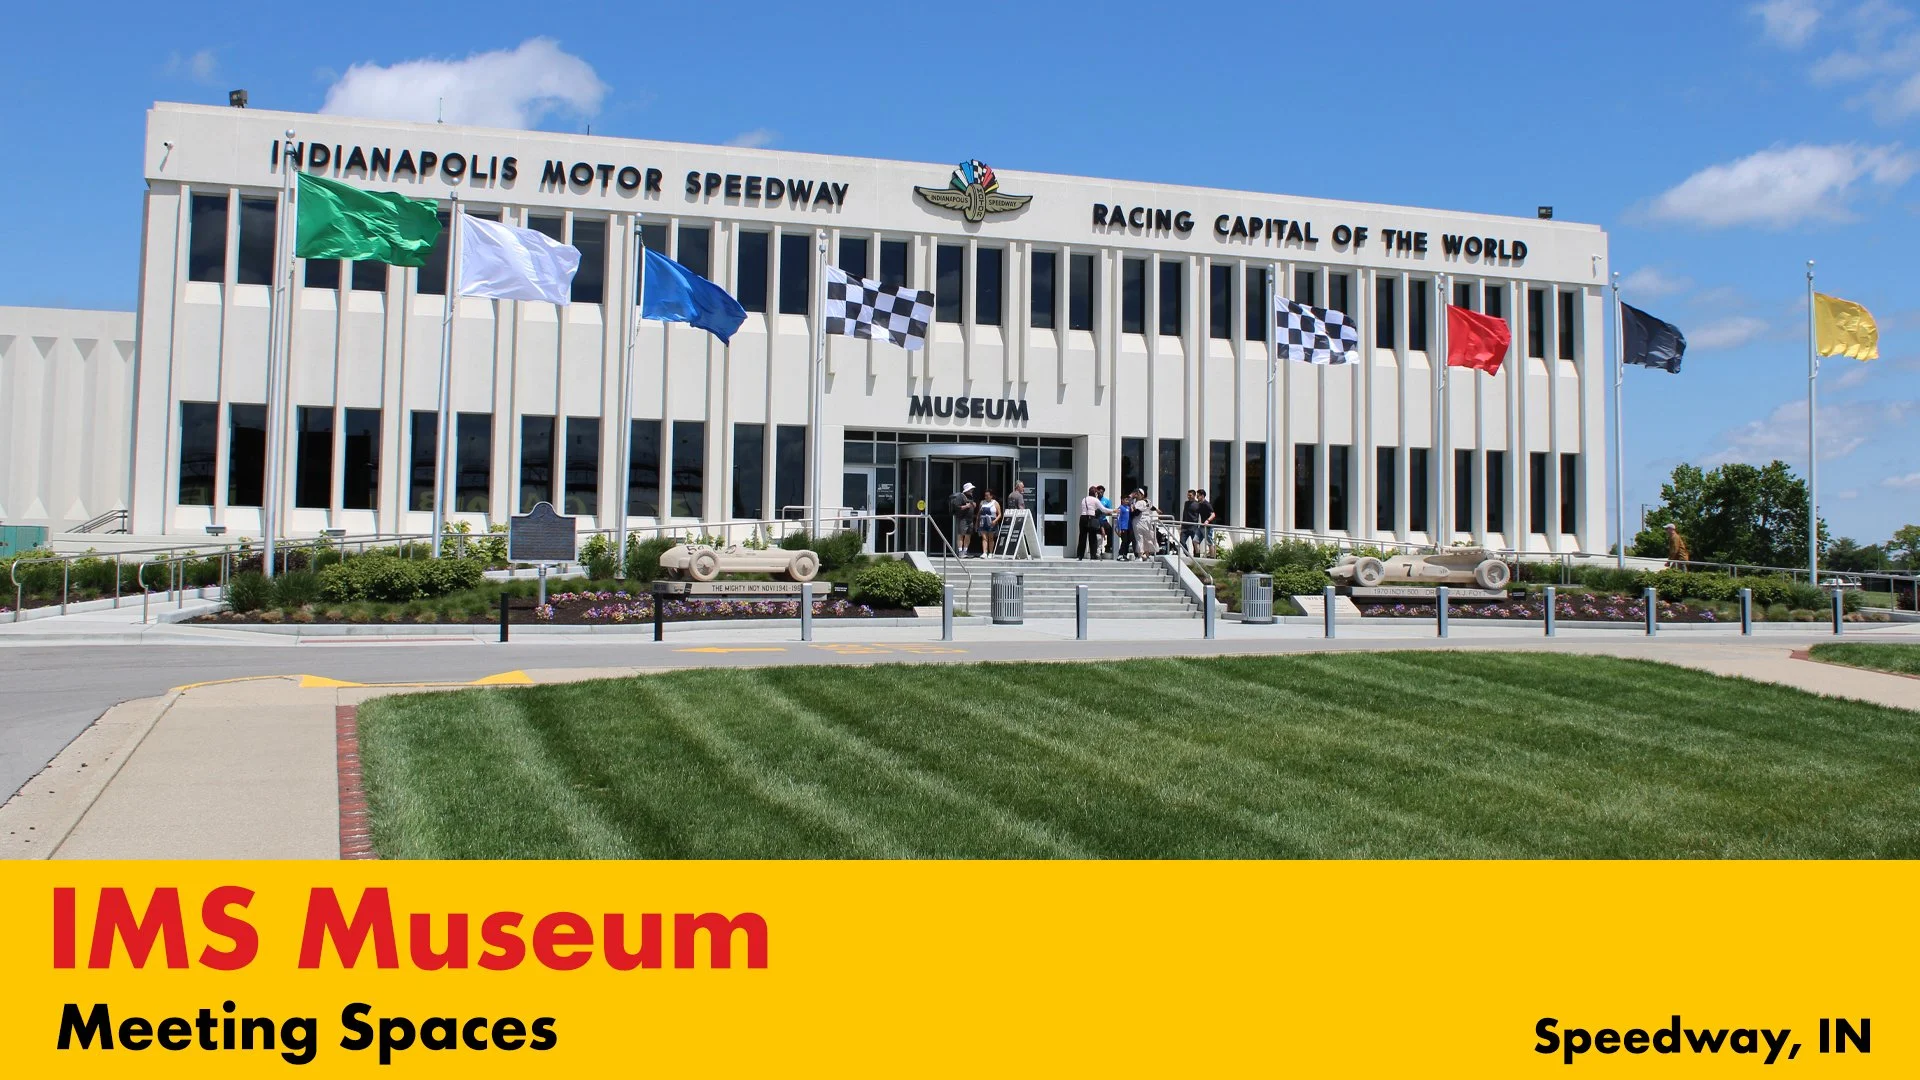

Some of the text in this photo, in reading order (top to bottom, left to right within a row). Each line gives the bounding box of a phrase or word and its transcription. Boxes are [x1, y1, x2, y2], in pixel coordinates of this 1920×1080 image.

[271, 140, 849, 206] INDIANAPOLIS MOTOR SPEEDWAY
[931, 194, 969, 204] INDIANAPOLIS
[988, 199, 1017, 208] SPEEDWAY
[1093, 203, 1528, 261] RACING CAPITAL OF THE WORLD
[908, 395, 1029, 421] MUSEUM
[1402, 563, 1412, 577] 7
[712, 584, 723, 592] THE
[724, 584, 745, 592] MIGHTY
[761, 584, 776, 592] NOVI
[1374, 588, 1389, 596] 1970
[1389, 588, 1405, 596] INDY
